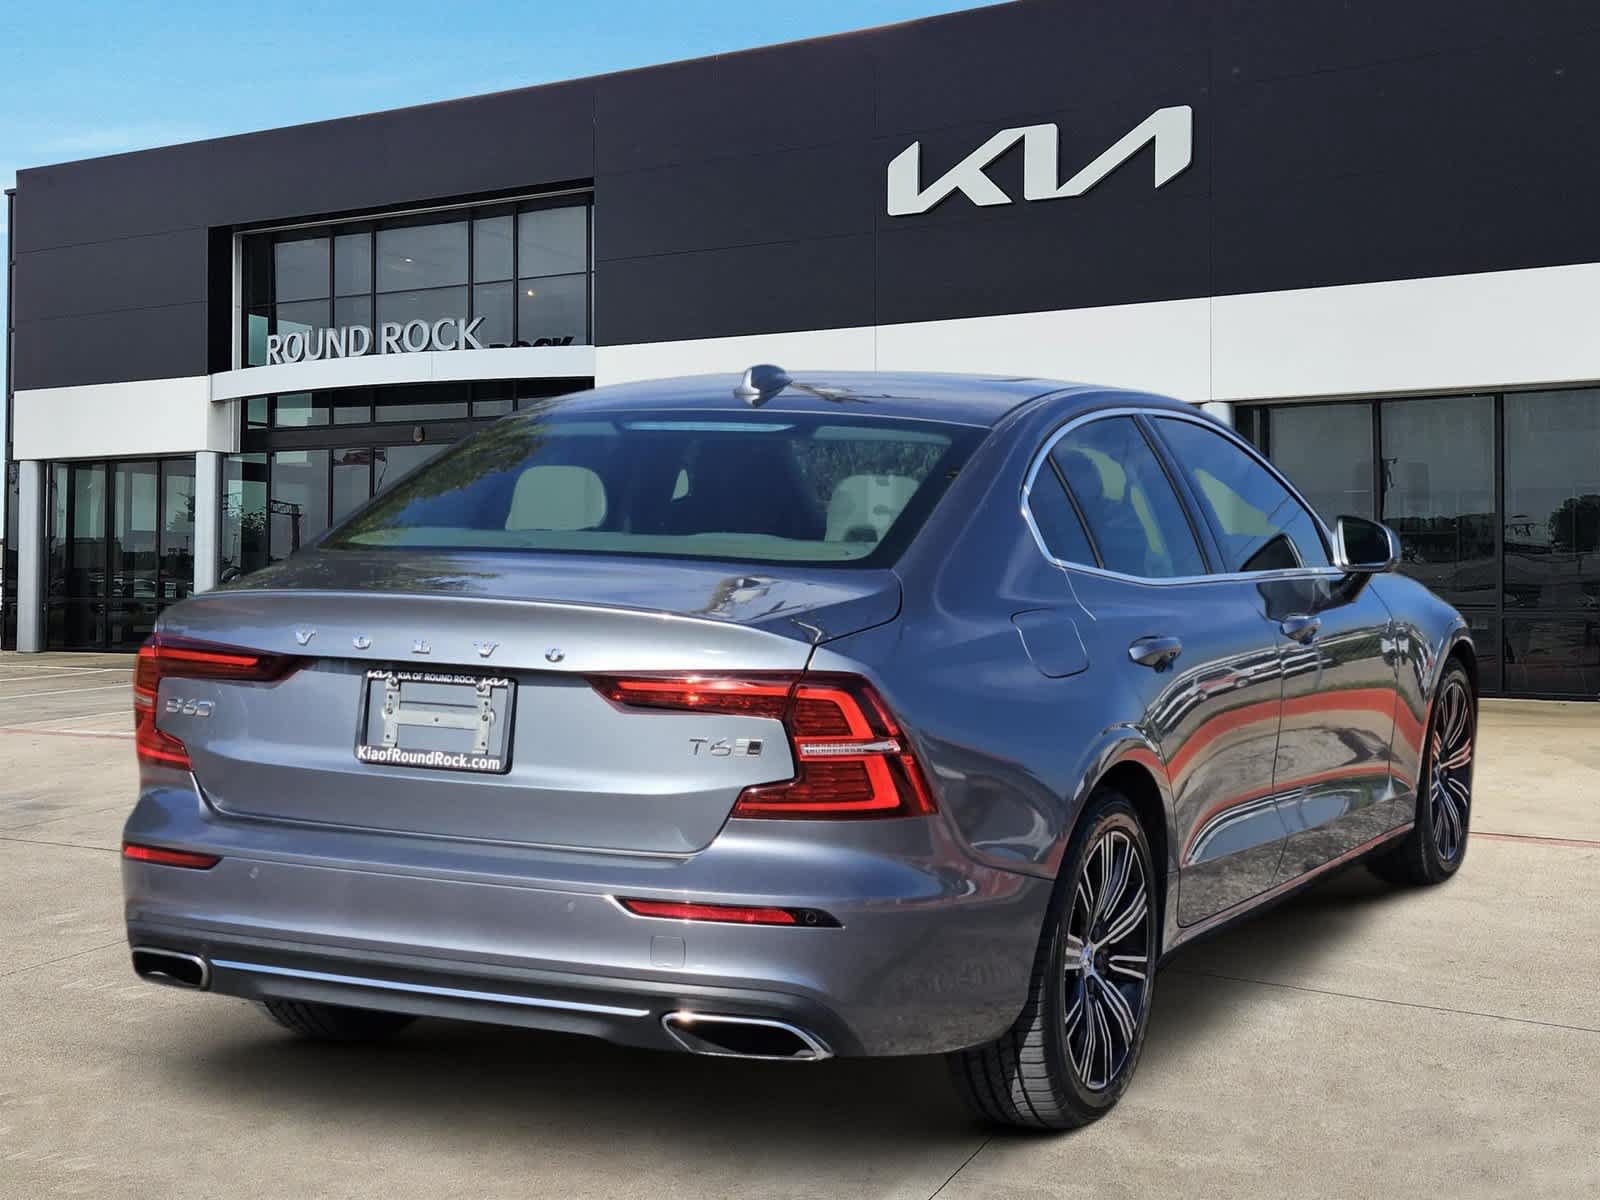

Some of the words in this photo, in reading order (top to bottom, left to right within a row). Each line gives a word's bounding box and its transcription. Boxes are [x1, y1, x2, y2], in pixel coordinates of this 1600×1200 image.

[265, 324, 371, 365] ROUND
[380, 316, 485, 354] ROCK
[295, 630, 566, 663] VOLVO
[397, 671, 411, 680] KIA
[412, 672, 423, 680] OF
[424, 672, 453, 683] ROUND
[454, 674, 476, 684] ROCK
[357, 745, 501, 771] KiaofRoundRock.com
[689, 738, 732, 757] T6
